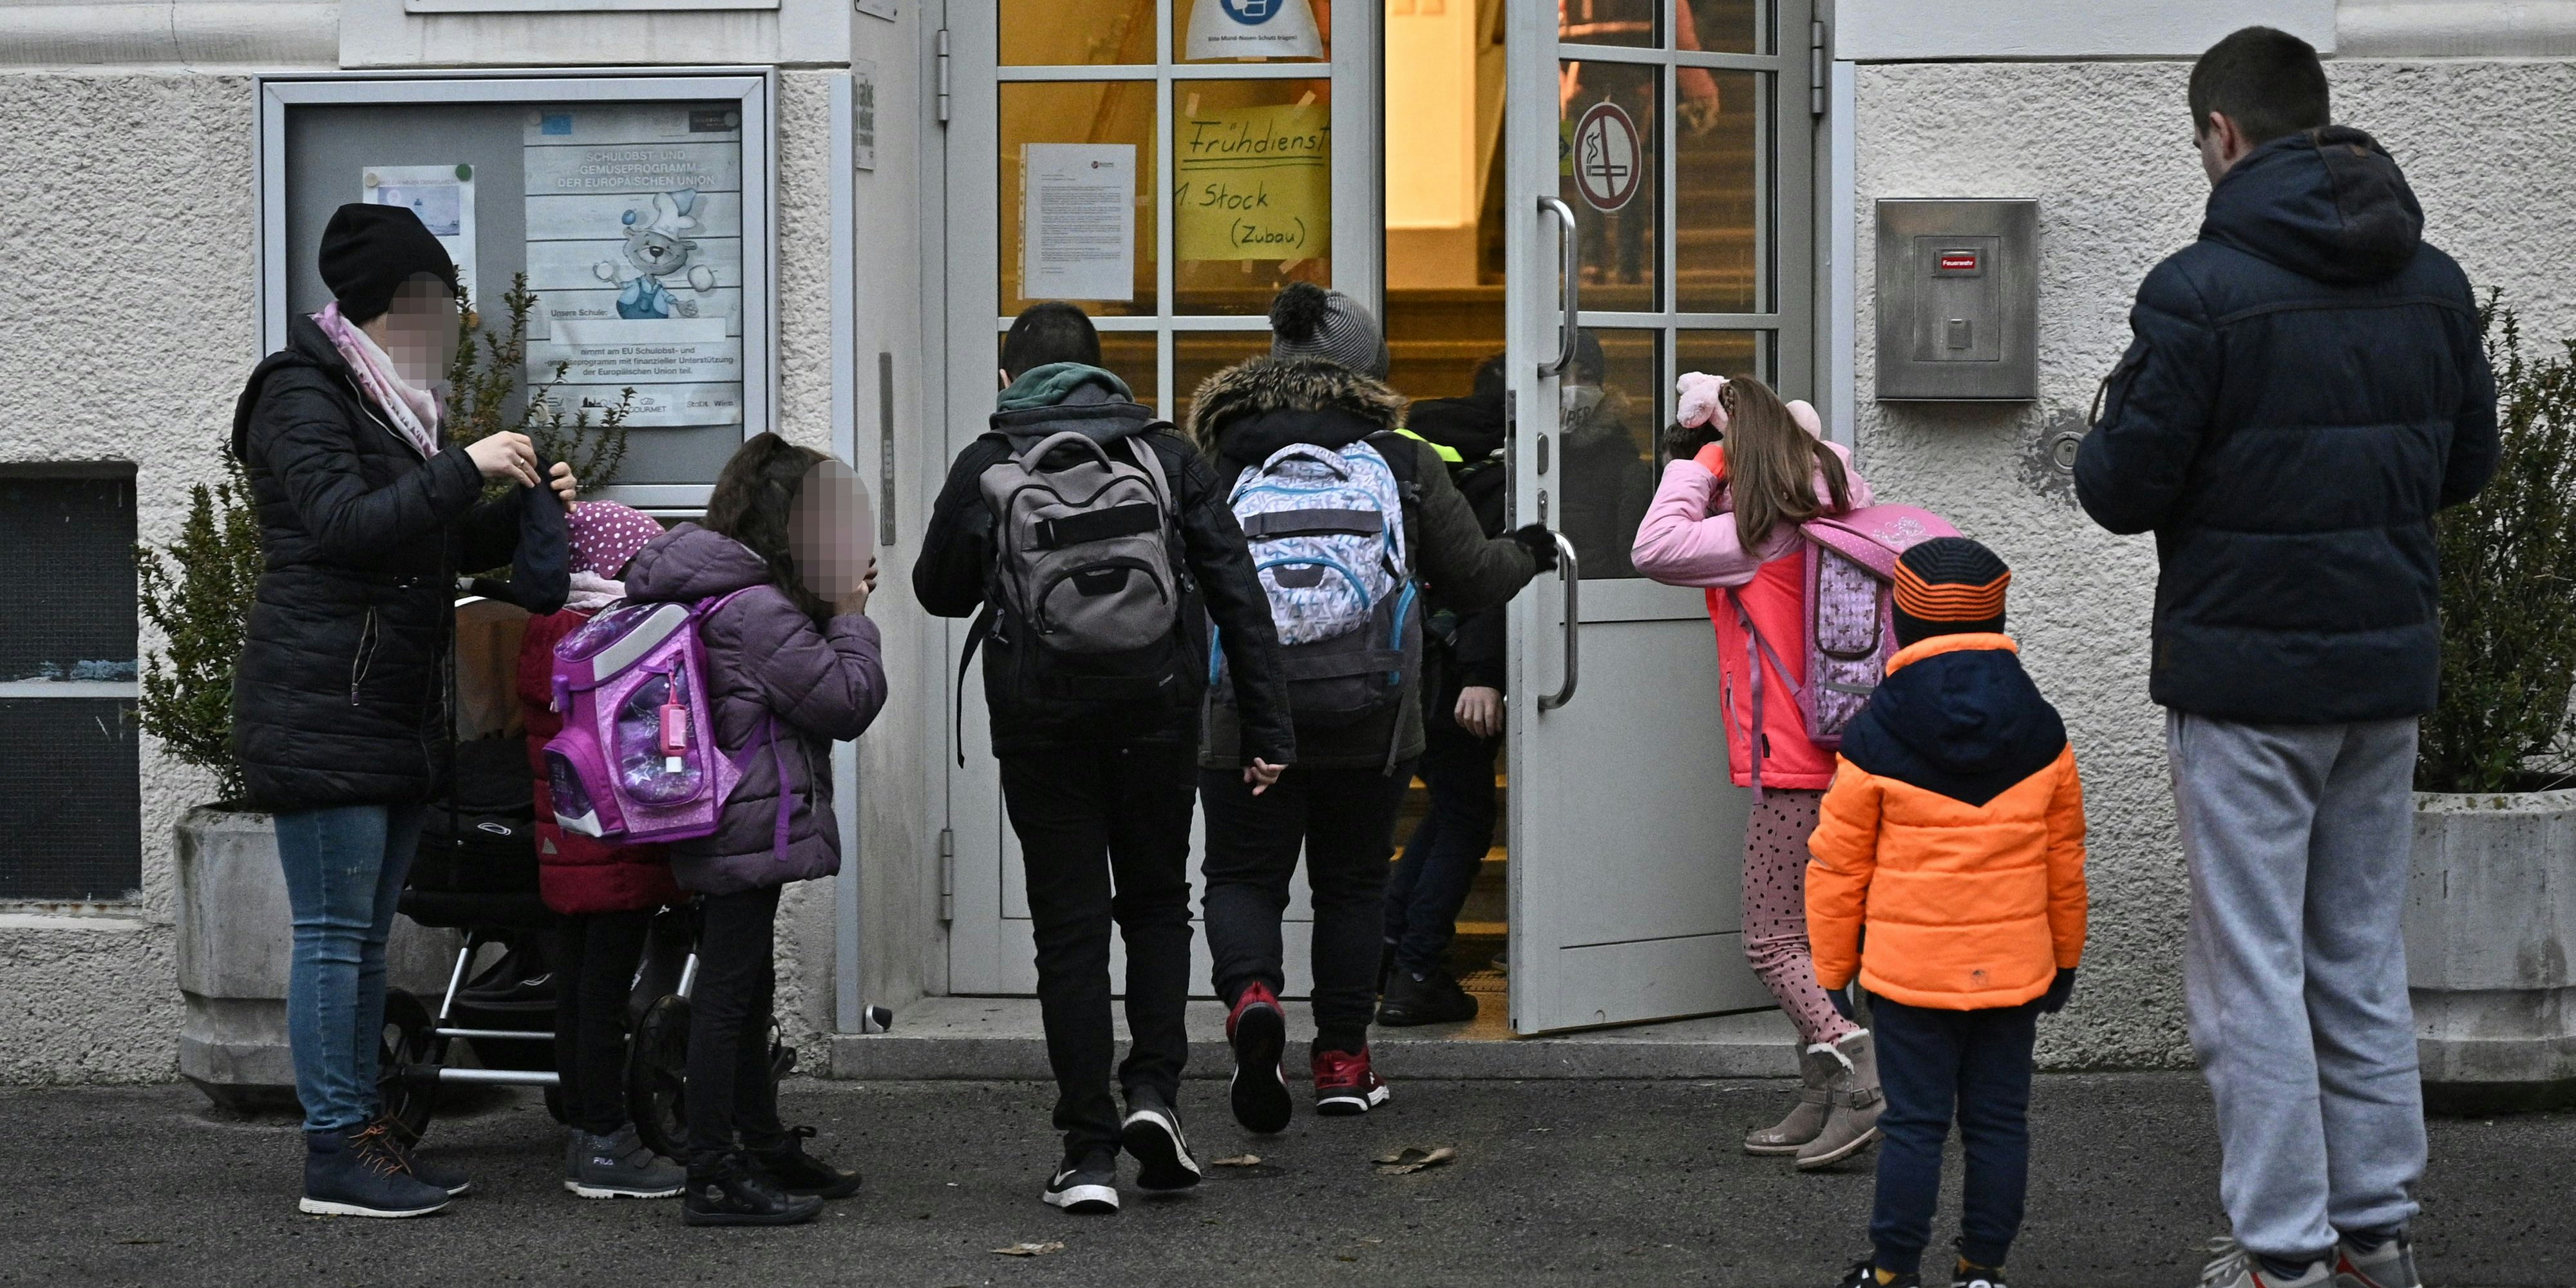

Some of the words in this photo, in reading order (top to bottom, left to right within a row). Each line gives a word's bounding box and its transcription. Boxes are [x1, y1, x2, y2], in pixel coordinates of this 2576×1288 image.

[1190, 119, 1331, 153] Frühdienst
[661, 150, 686, 160] UND
[580, 162, 696, 174] GEMÜSEPROGRAMM
[558, 178, 581, 187] DER
[677, 175, 715, 185] UNION
[1199, 180, 1268, 211] Stock
[1231, 217, 1305, 249] (Zubau)
[679, 355, 734, 364] Unterstützung
[598, 367, 652, 376] Europäischen
[593, 1157, 614, 1165] FILA
